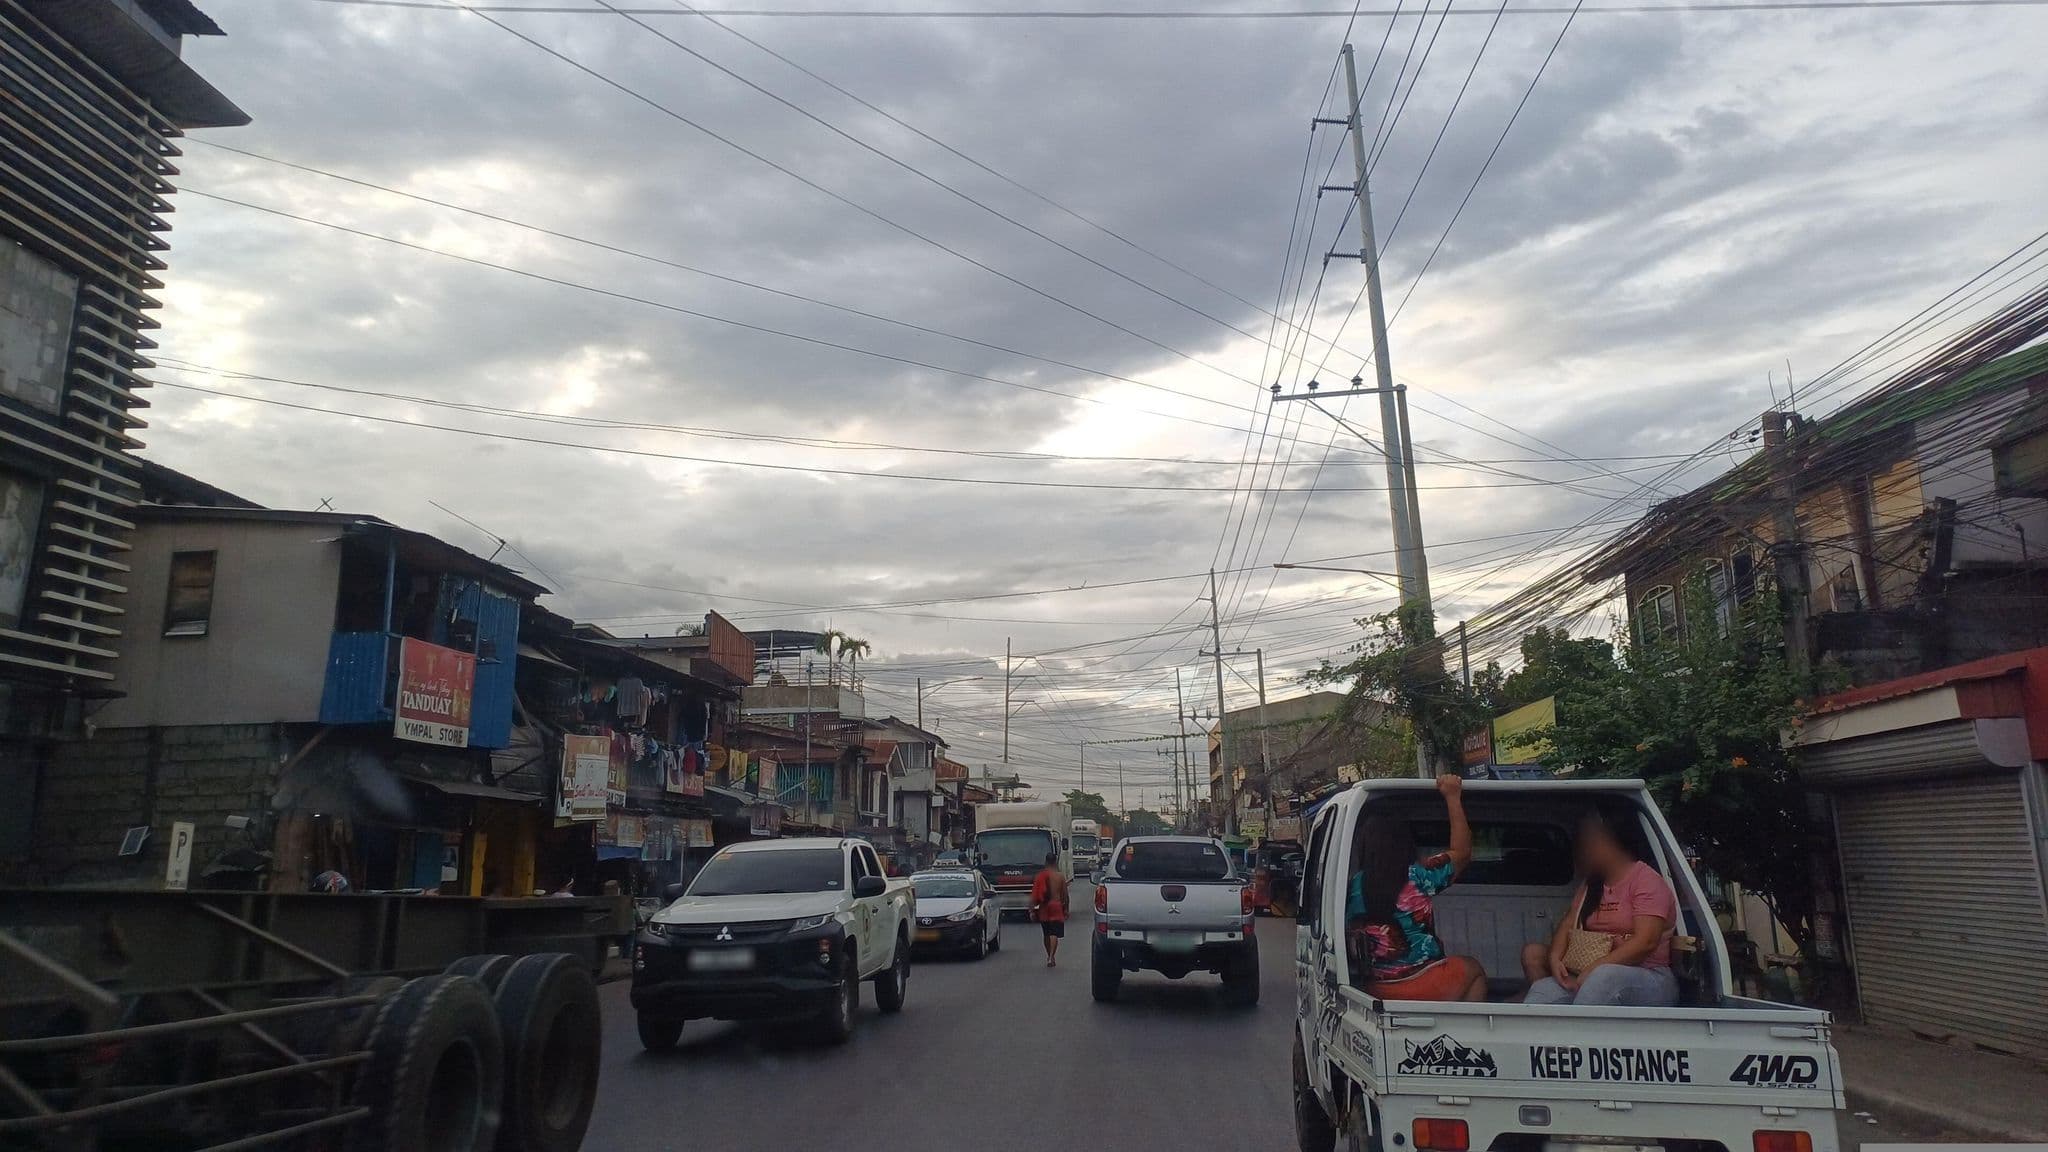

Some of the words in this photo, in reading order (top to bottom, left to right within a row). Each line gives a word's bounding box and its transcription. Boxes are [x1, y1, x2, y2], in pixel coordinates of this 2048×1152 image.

[402, 690, 452, 715] TANDUAY
[404, 722, 433, 739] YMPAL
[439, 727, 464, 744] STORE
[1399, 1064, 1497, 1077] MIGHTY
[1529, 1046, 1583, 1079] KEEP
[1588, 1047, 1692, 1083] DISTANCE
[1729, 1054, 1819, 1086] 4WD
